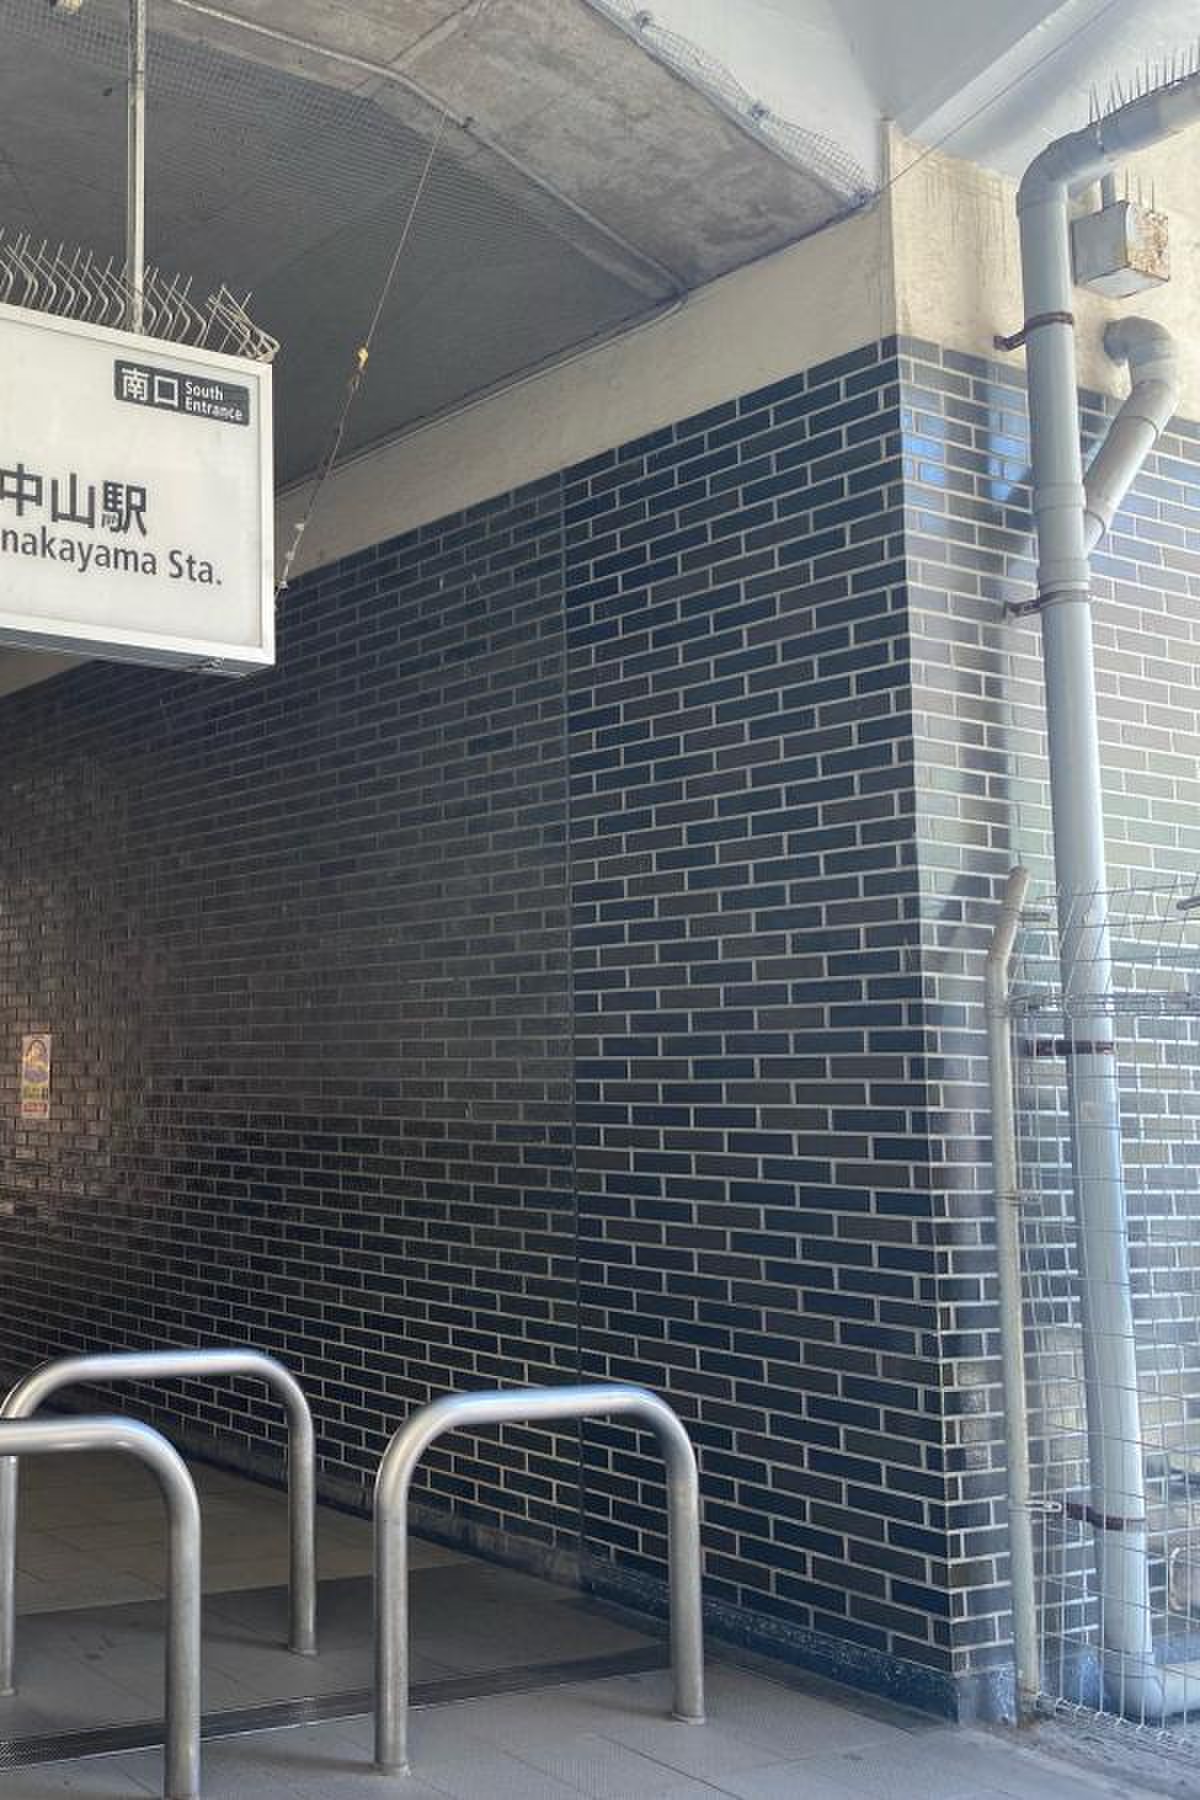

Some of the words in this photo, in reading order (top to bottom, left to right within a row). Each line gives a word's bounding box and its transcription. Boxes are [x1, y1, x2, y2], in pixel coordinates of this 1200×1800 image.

[121, 367, 179, 408] 南口
[184, 381, 224, 401] South
[185, 397, 243, 421] Entrance
[168, 549, 223, 586] Sta.
